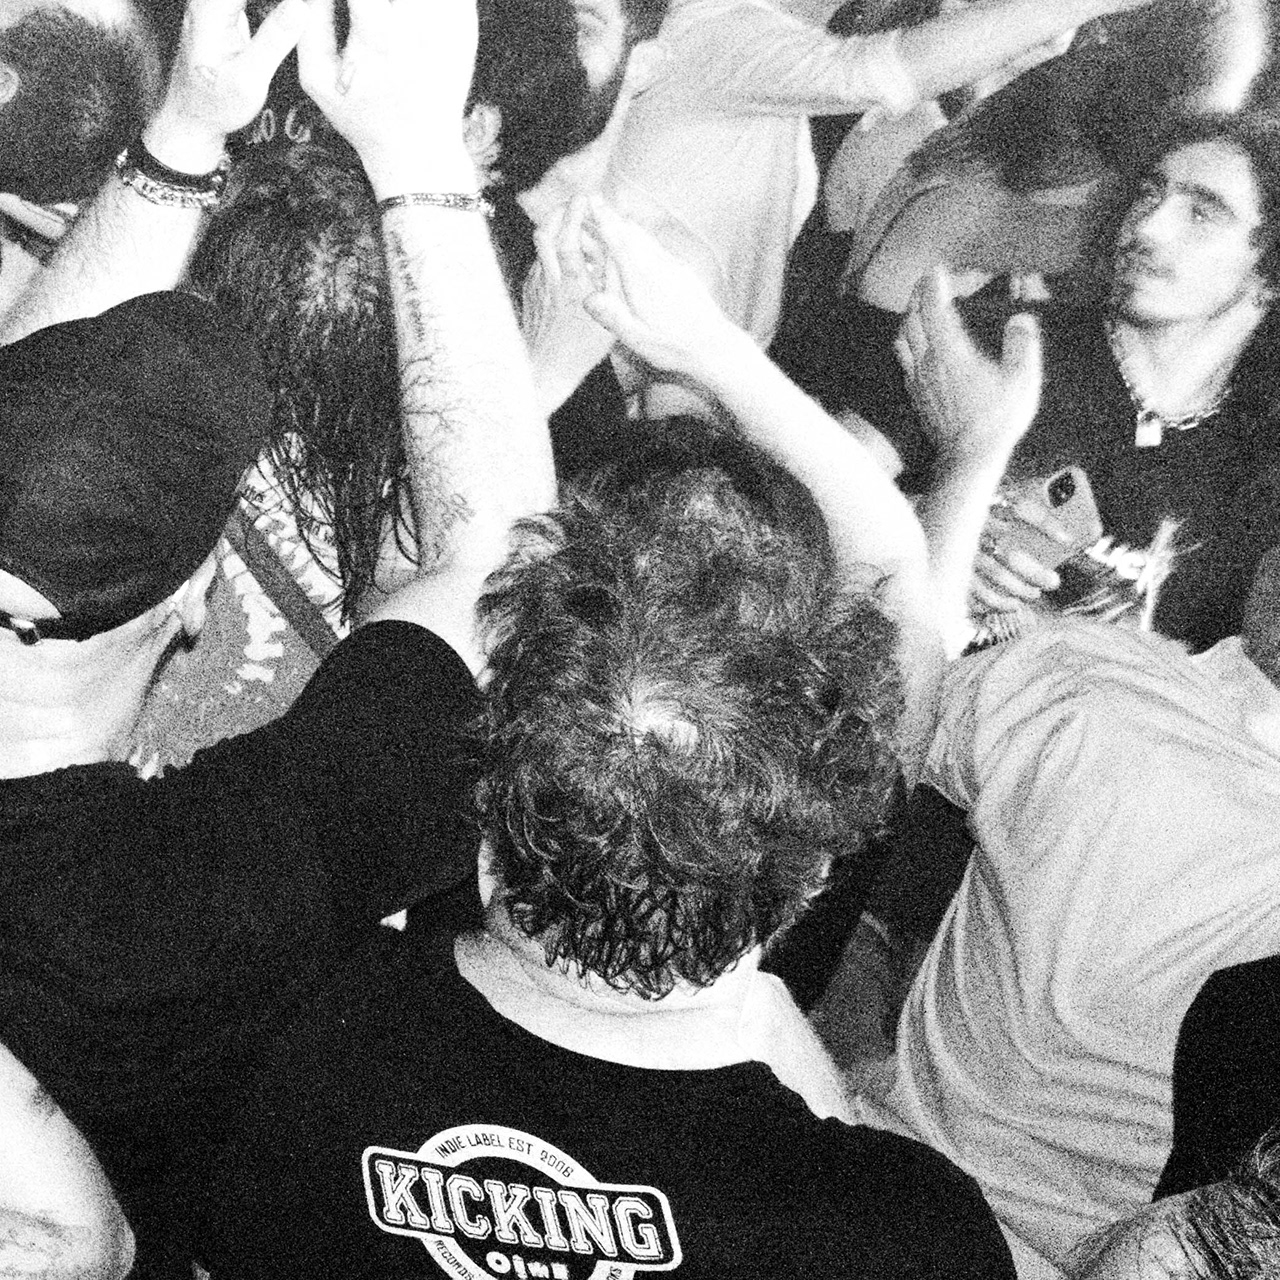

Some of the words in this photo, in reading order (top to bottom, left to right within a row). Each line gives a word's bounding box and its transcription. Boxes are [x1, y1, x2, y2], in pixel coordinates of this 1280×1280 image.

[434, 1135, 466, 1159] INDIE
[466, 1132, 505, 1148] LABEL
[508, 1136, 534, 1156] EST
[375, 1159, 664, 1261] KICKING
